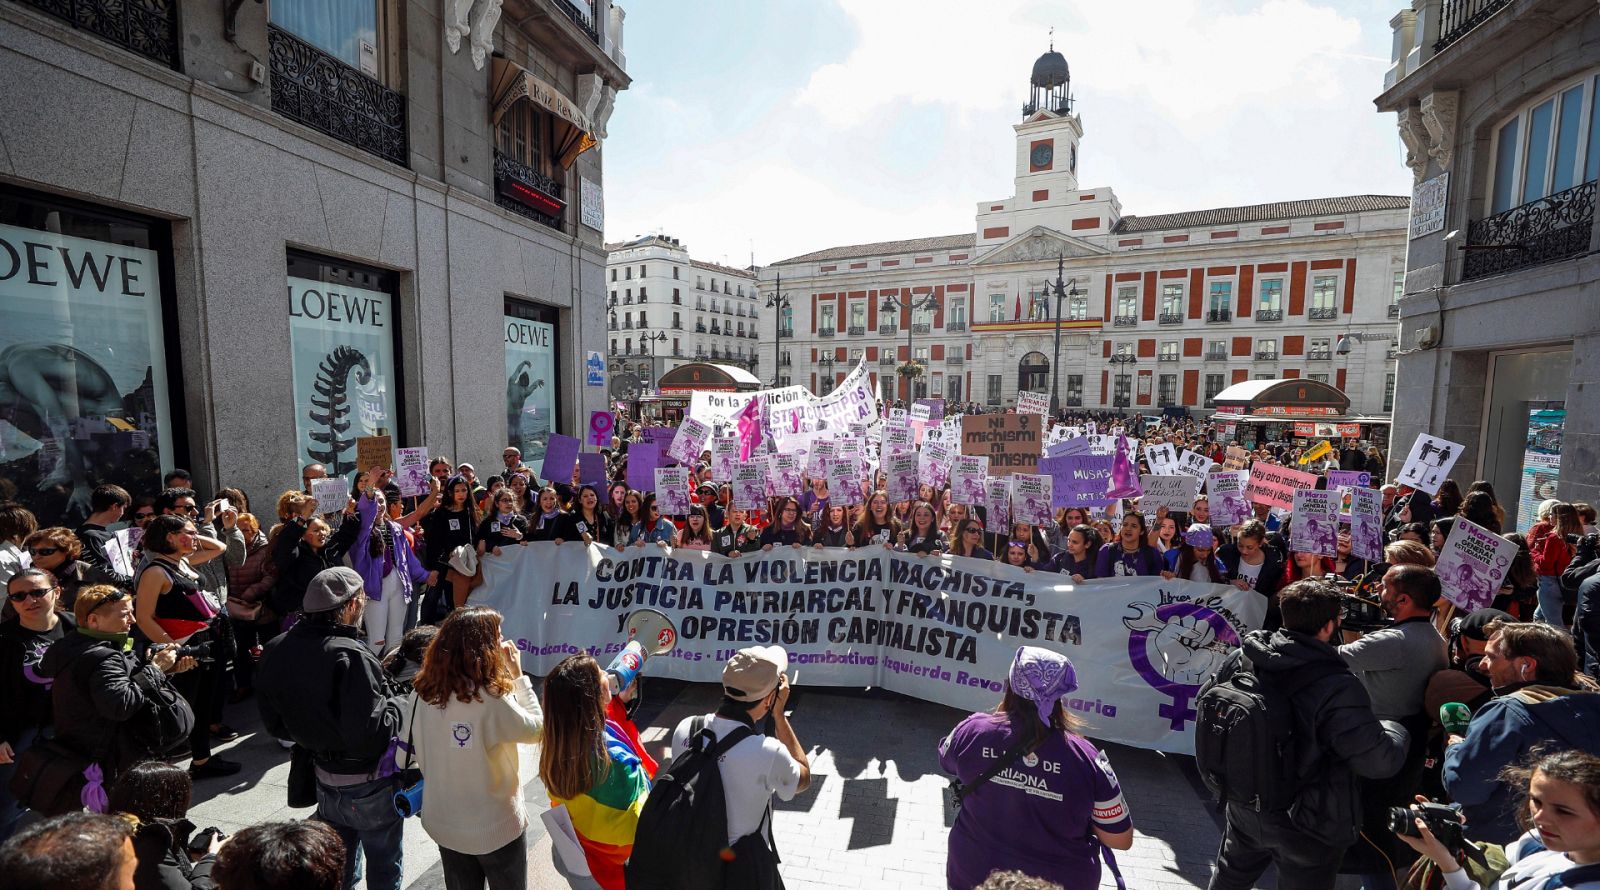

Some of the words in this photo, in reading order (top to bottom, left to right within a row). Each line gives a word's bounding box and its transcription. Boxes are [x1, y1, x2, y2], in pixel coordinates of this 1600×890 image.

[709, 395, 724, 407] Por
[729, 396, 740, 408] la
[988, 418, 1005, 428] Ni
[990, 443, 1005, 453] ni
[1073, 468, 1111, 480] MUSAS
[1178, 465, 1205, 479] LIBERTAD
[1251, 467, 1265, 479] Hay
[1267, 473, 1280, 484] otro
[1282, 476, 1312, 490] maltrato
[1254, 485, 1274, 496] medios
[1305, 491, 1328, 499] Marzo
[1459, 521, 1467, 530] 8
[1468, 525, 1499, 548] Marzo
[1467, 535, 1496, 554] HUELGA
[1454, 542, 1491, 566] ESTUDIANTIL
[1461, 539, 1494, 561] GENERAL
[596, 556, 695, 582] CONTRA
[703, 562, 734, 586] LA
[743, 557, 882, 586] VIOLENCIA
[889, 558, 1036, 606] MACHISTA,
[552, 581, 580, 605] LA
[588, 582, 704, 610] JUSTICIA
[713, 586, 876, 615] PATRIARCAL
[882, 588, 894, 614] Y
[897, 590, 1083, 646] FRANQUISTA
[516, 637, 579, 657] Sindicato
[585, 645, 601, 657] de
[616, 611, 631, 634] Y
[680, 611, 819, 644] OPRESIÓN
[827, 616, 978, 664] CAPITALISTA
[982, 747, 998, 759] EL
[1043, 760, 1061, 774] DE
[997, 766, 1049, 791] RIADNA
[1092, 802, 1123, 817] SERVICIO
